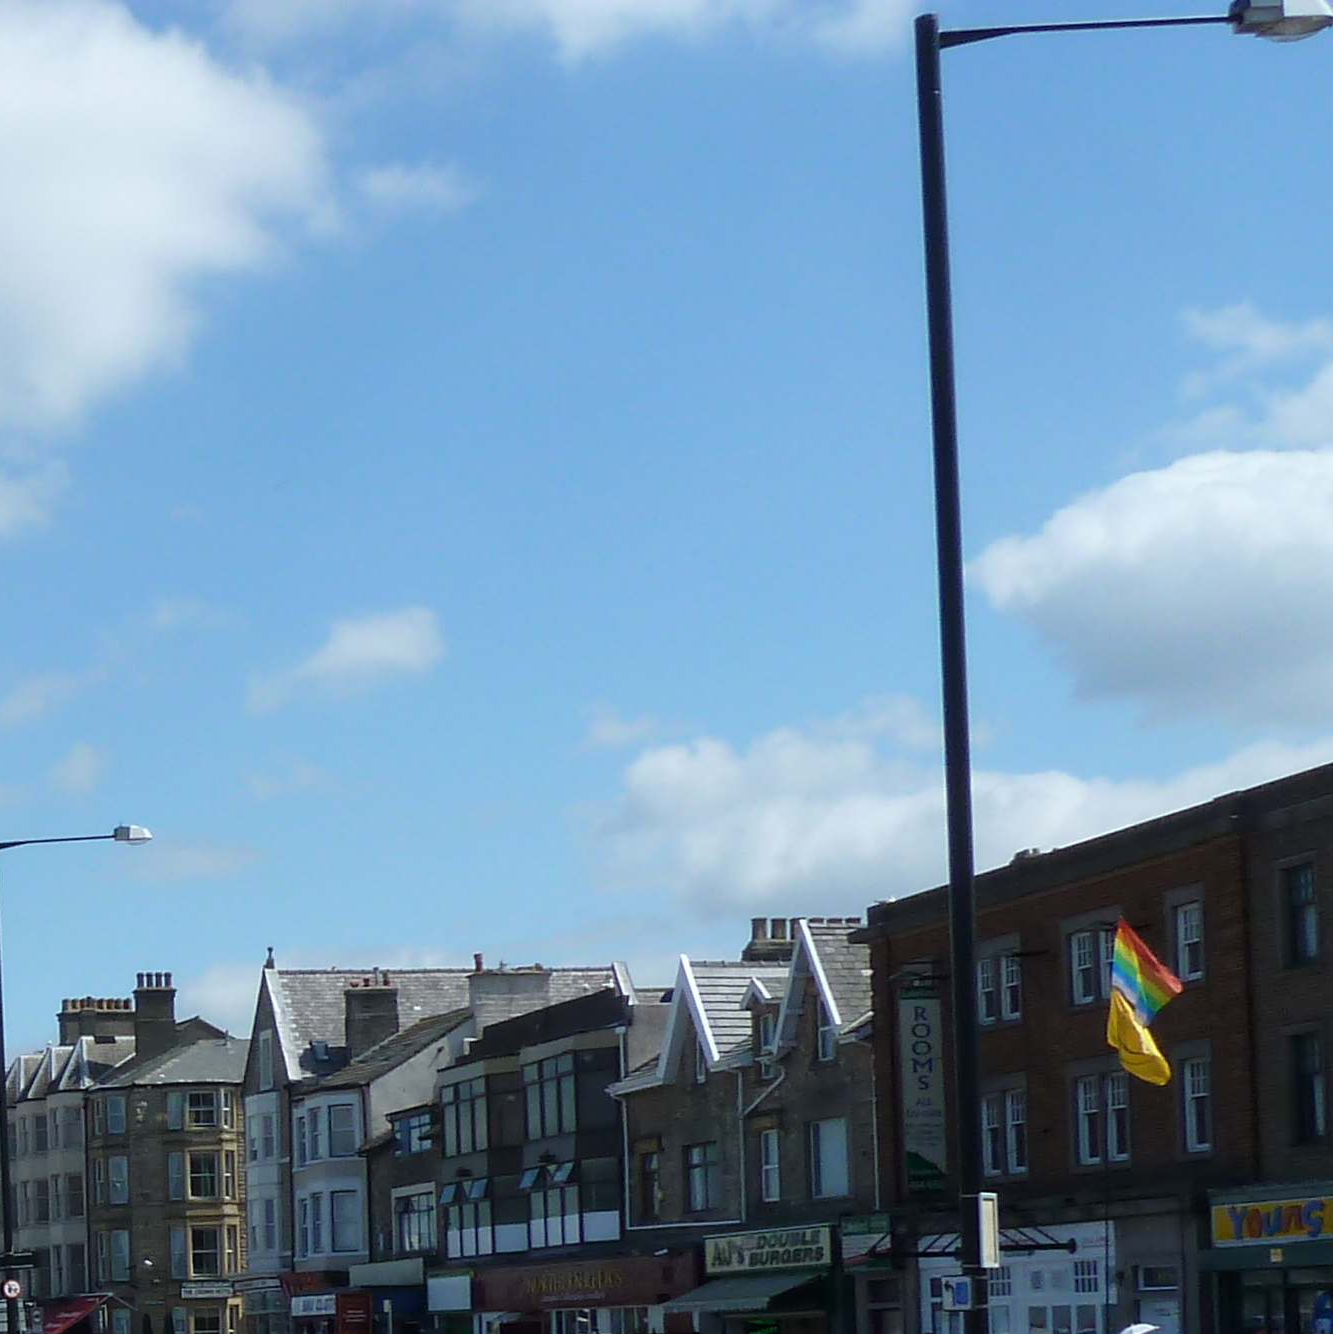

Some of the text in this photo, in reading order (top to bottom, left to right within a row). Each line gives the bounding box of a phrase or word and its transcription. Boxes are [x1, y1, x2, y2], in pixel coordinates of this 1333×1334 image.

[911, 1006, 933, 1090] ROOMS
[756, 1230, 821, 1249] DOUBLE
[748, 1246, 824, 1267] BURGERS
